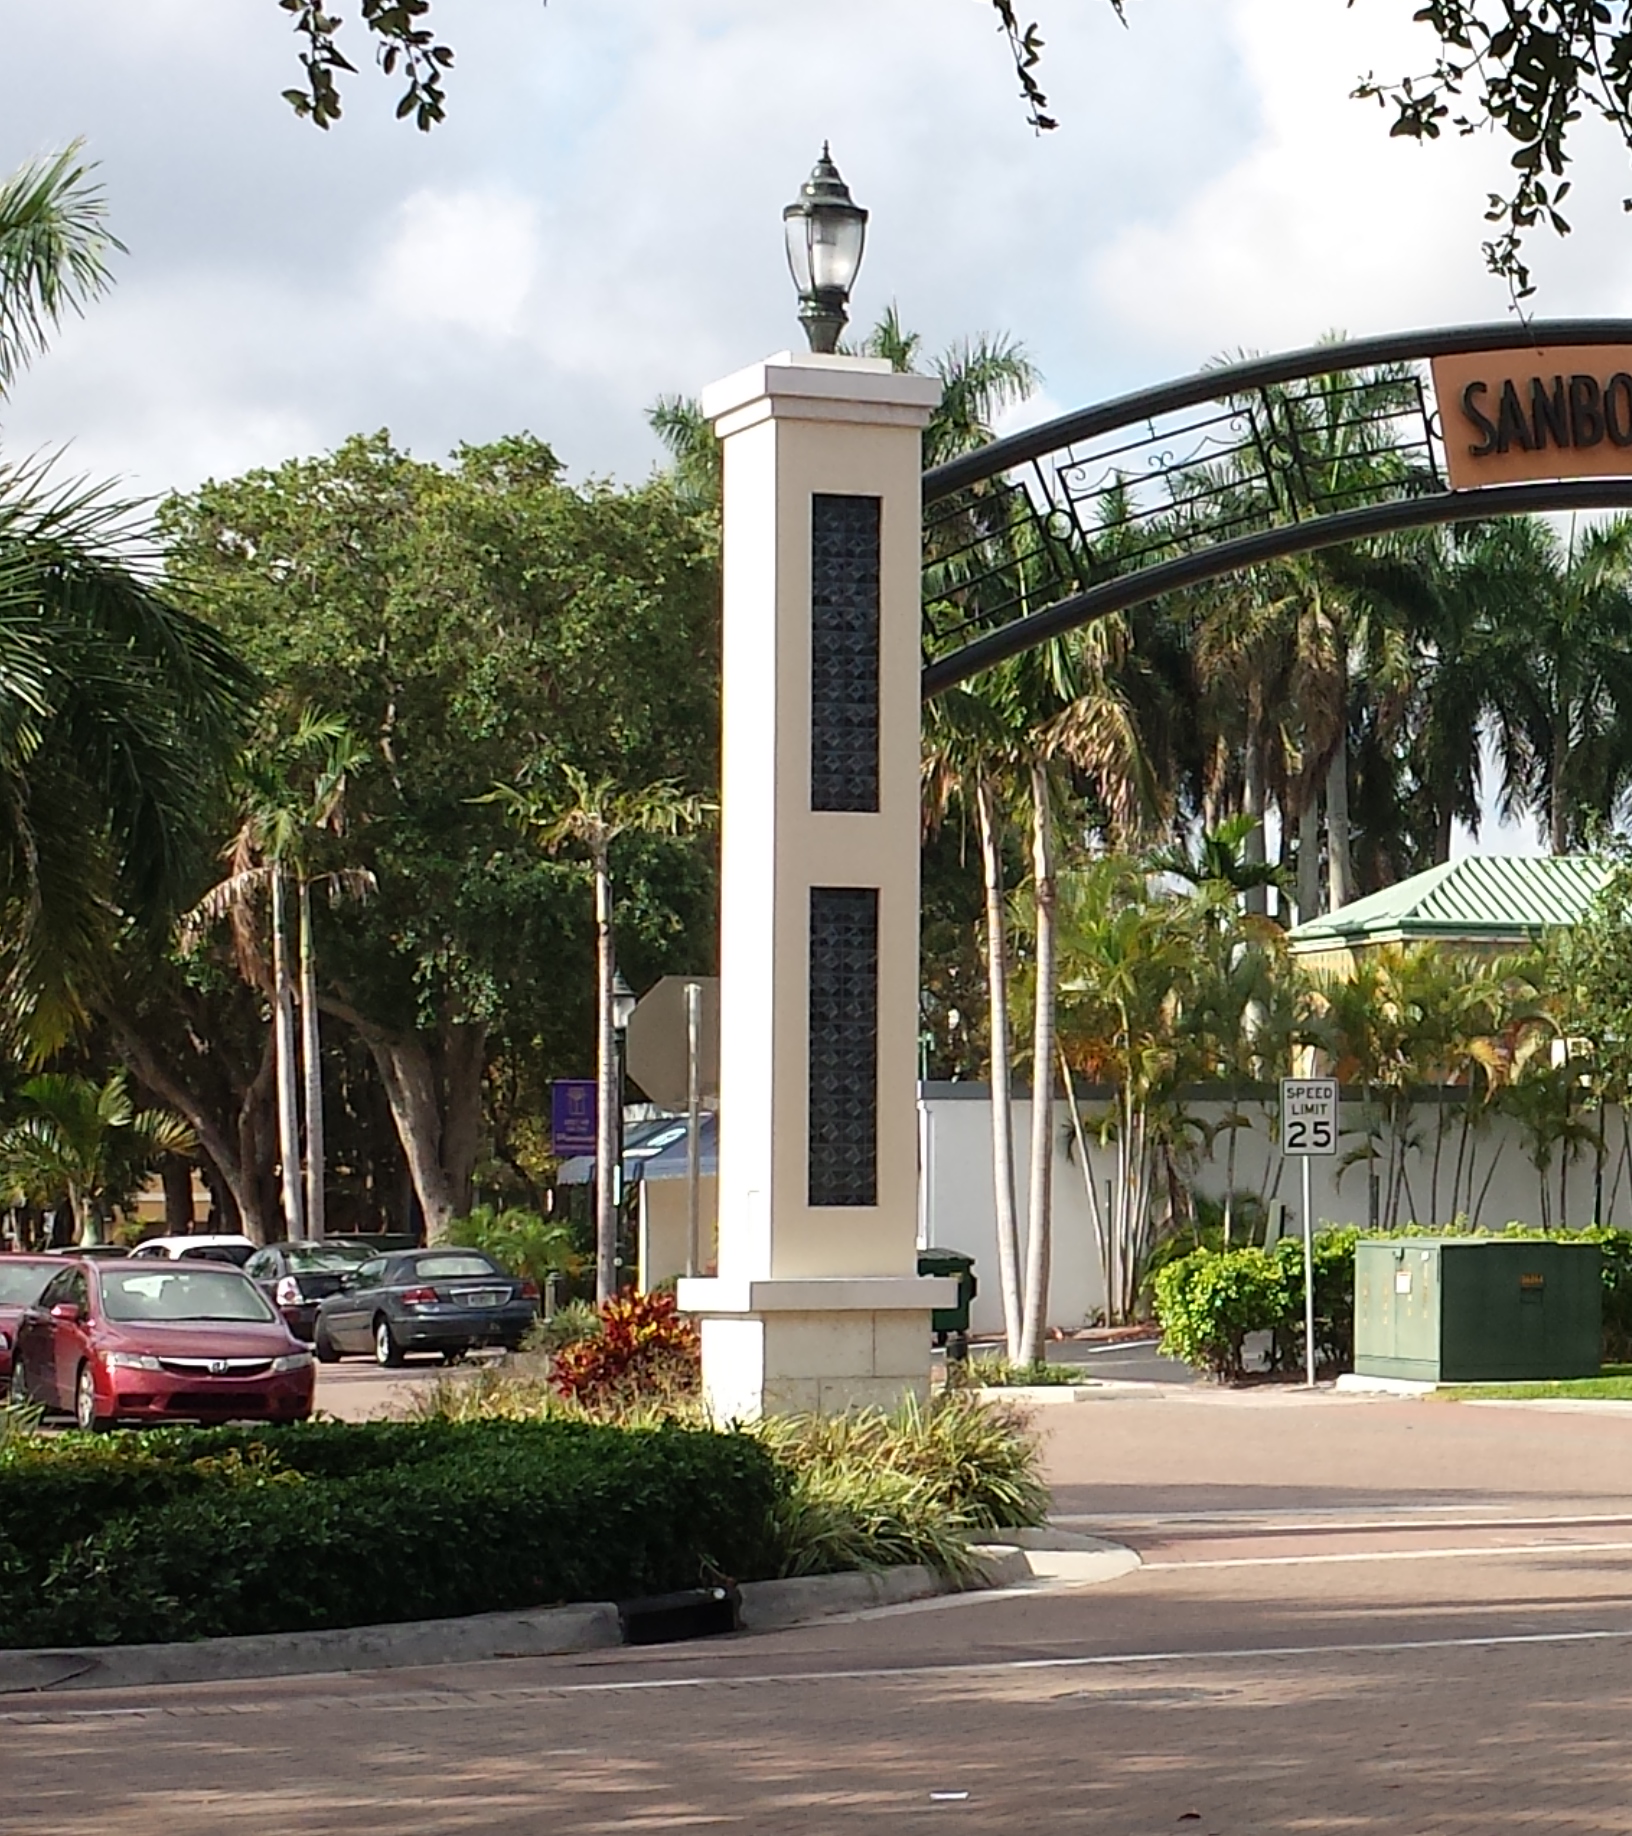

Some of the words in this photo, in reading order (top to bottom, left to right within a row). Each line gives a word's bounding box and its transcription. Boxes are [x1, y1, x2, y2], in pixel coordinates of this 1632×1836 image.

[1286, 1087, 1333, 1099] SPEED
[1291, 1103, 1328, 1115] LIMIT
[1288, 1121, 1331, 1148] 25
